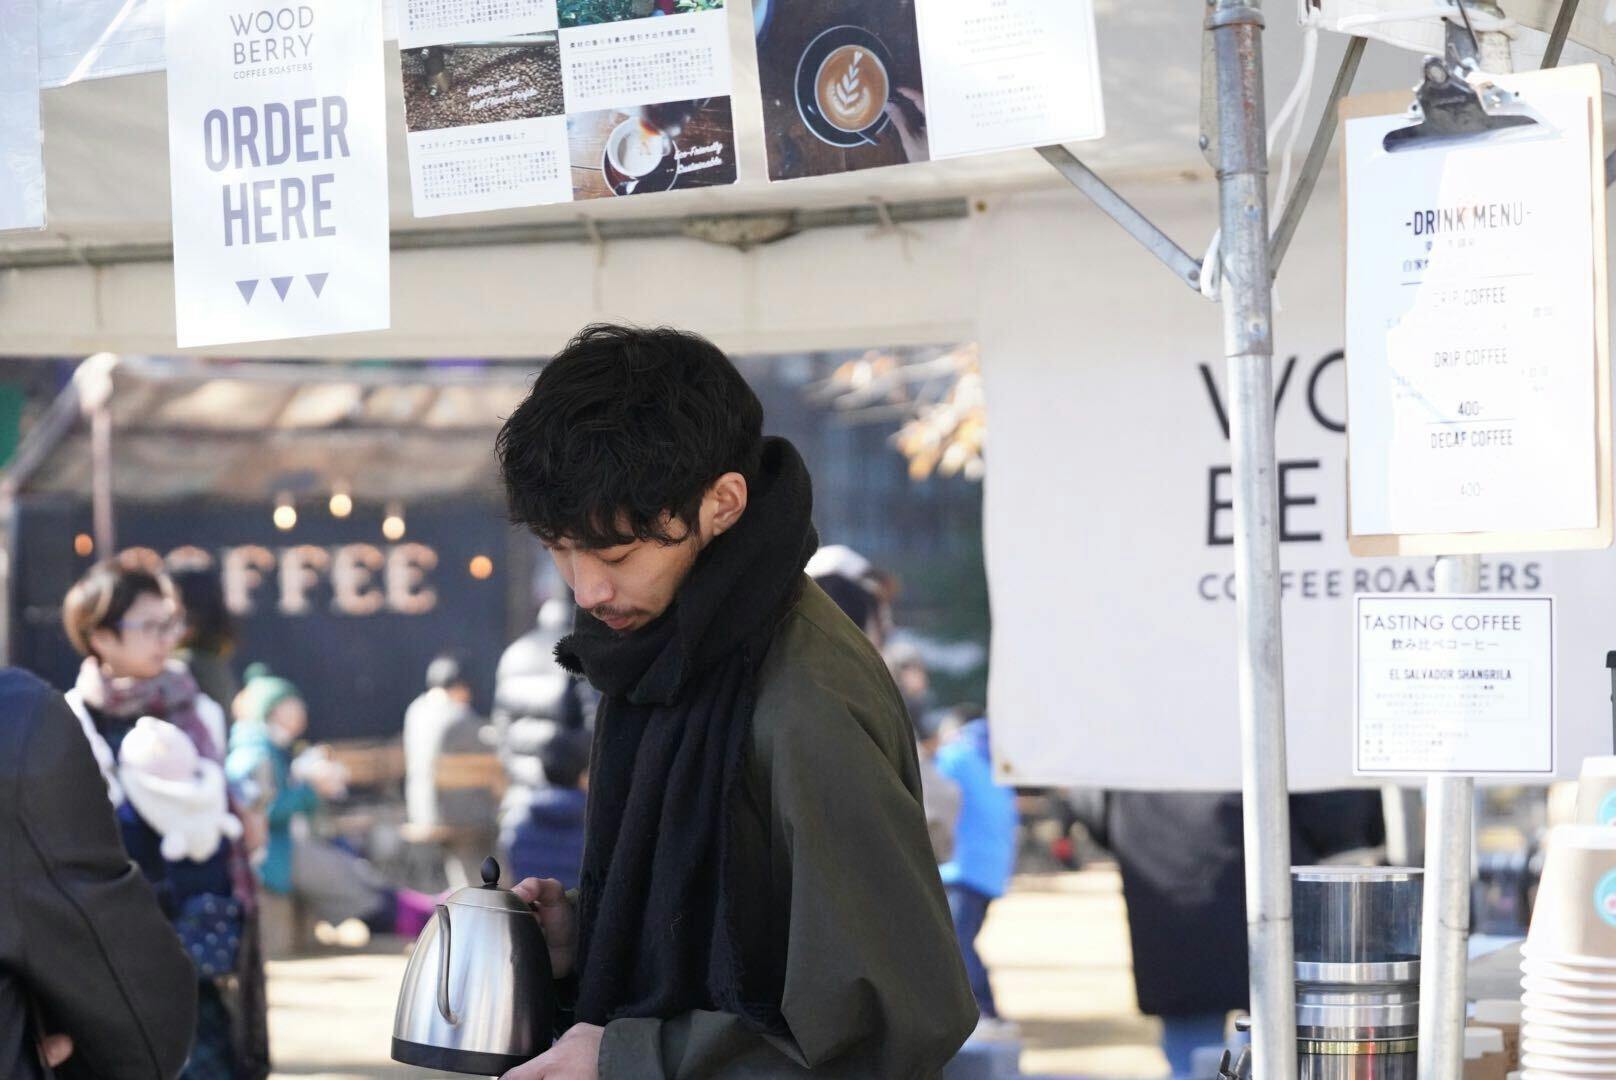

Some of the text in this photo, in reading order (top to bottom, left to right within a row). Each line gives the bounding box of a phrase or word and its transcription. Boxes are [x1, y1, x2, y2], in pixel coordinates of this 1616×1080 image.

[230, 6, 314, 36] WOOD
[234, 33, 313, 65] BERRY
[234, 63, 313, 79] COFFEE ROASTERS
[204, 95, 350, 172] ORDER
[222, 173, 336, 246] HERE
[1464, 286, 1505, 305] COFFEE
[1433, 347, 1507, 368] DRIP COFFEE
[1431, 428, 1512, 448] DECAF COFFEE
[1363, 614, 1521, 631] TASTING COFFEE
[1391, 638, 1500, 651] 飲み比べコーヒー
[1389, 668, 1512, 680] EL SALVADOR SHANGRILA
